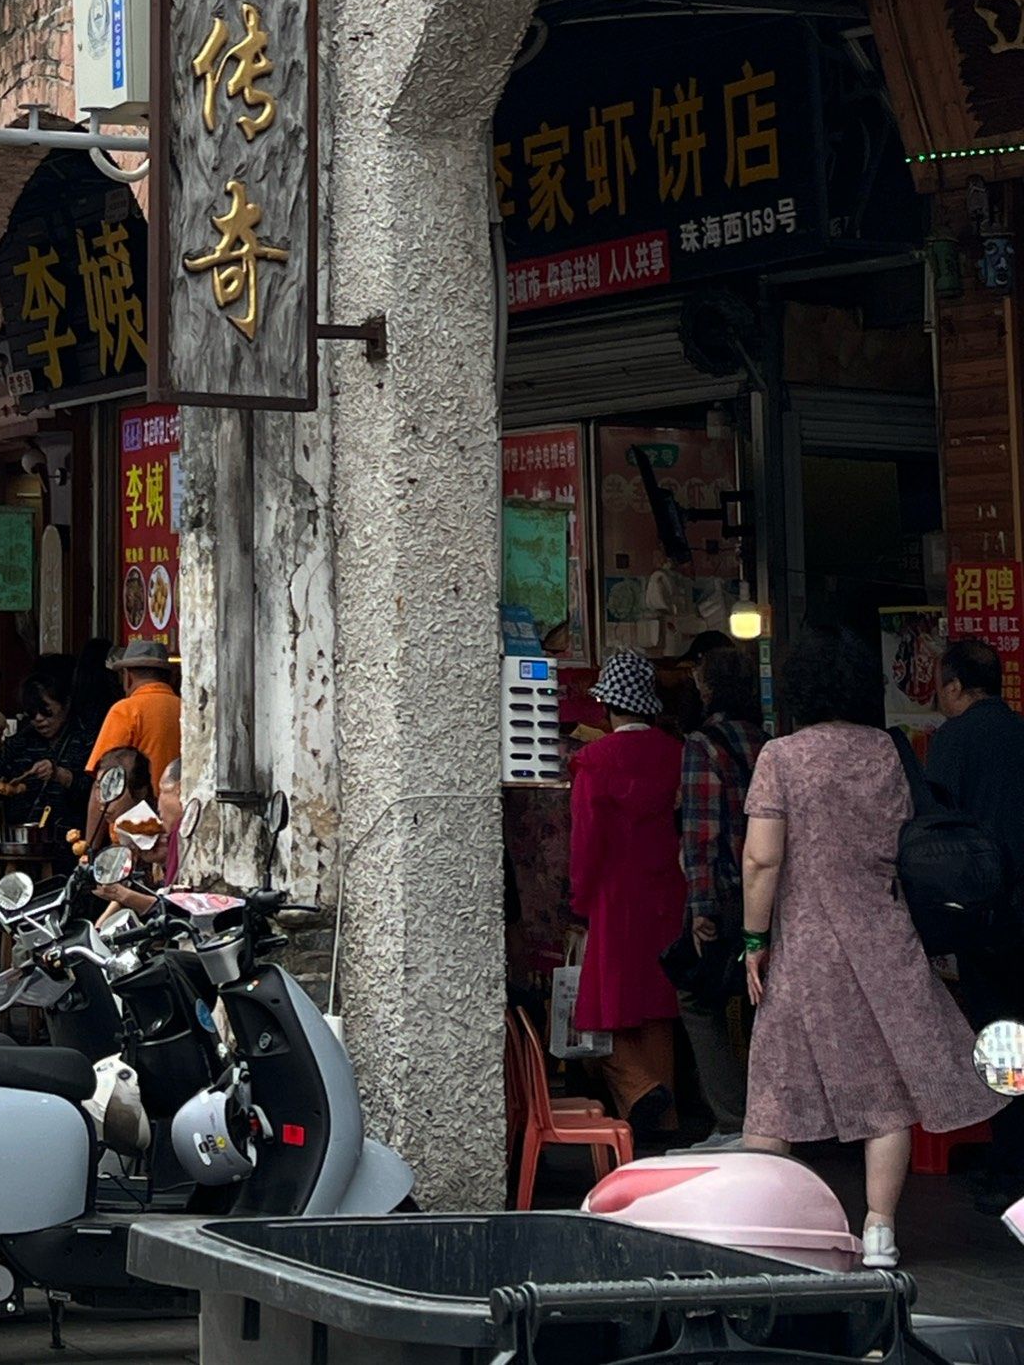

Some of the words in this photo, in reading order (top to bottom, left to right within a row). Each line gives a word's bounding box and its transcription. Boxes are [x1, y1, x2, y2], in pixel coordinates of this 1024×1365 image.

[680, 197, 798, 253] 珠海西159号
[608, 239, 665, 285] 人人共享
[13, 220, 149, 390] 李姨
[124, 462, 165, 529] 李姨
[955, 566, 1016, 612] 招聘
